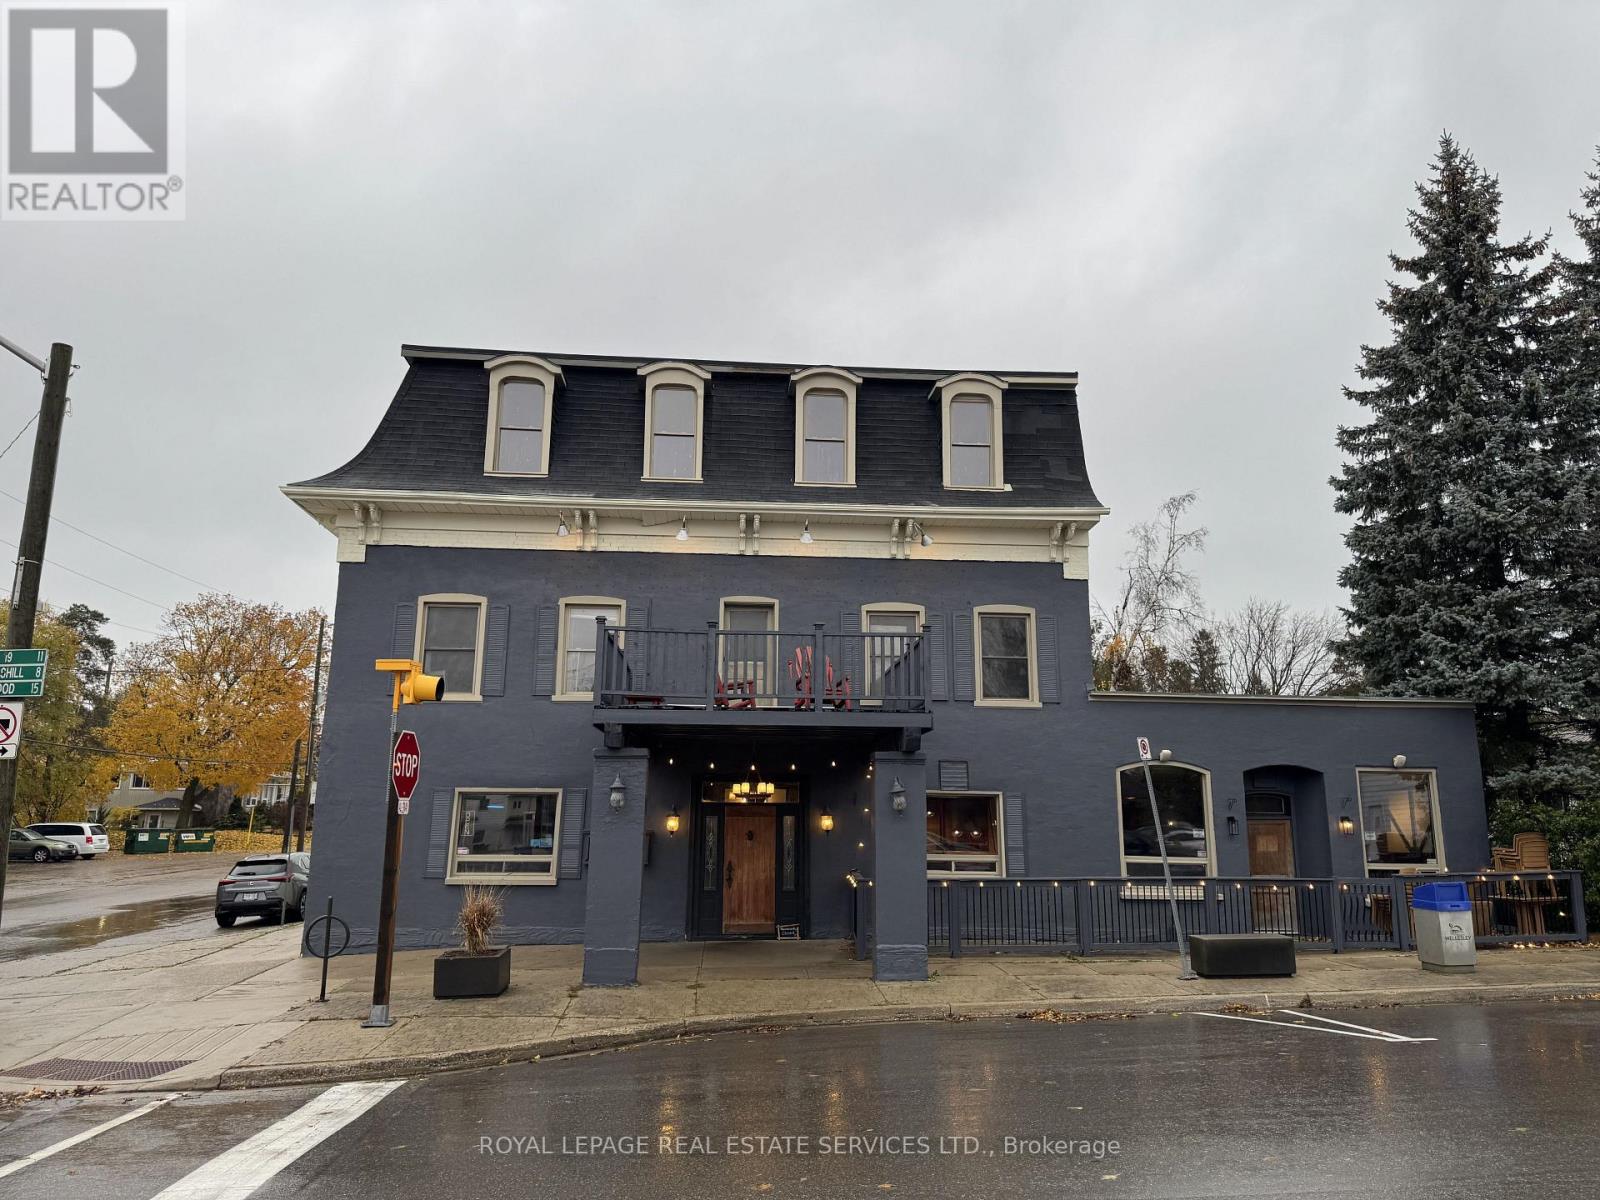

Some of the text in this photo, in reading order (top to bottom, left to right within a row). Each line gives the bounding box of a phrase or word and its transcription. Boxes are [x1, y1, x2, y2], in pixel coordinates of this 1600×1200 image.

[35, 666, 41, 677] 8
[31, 682, 39, 694] 15
[395, 752, 418, 777] STOP
